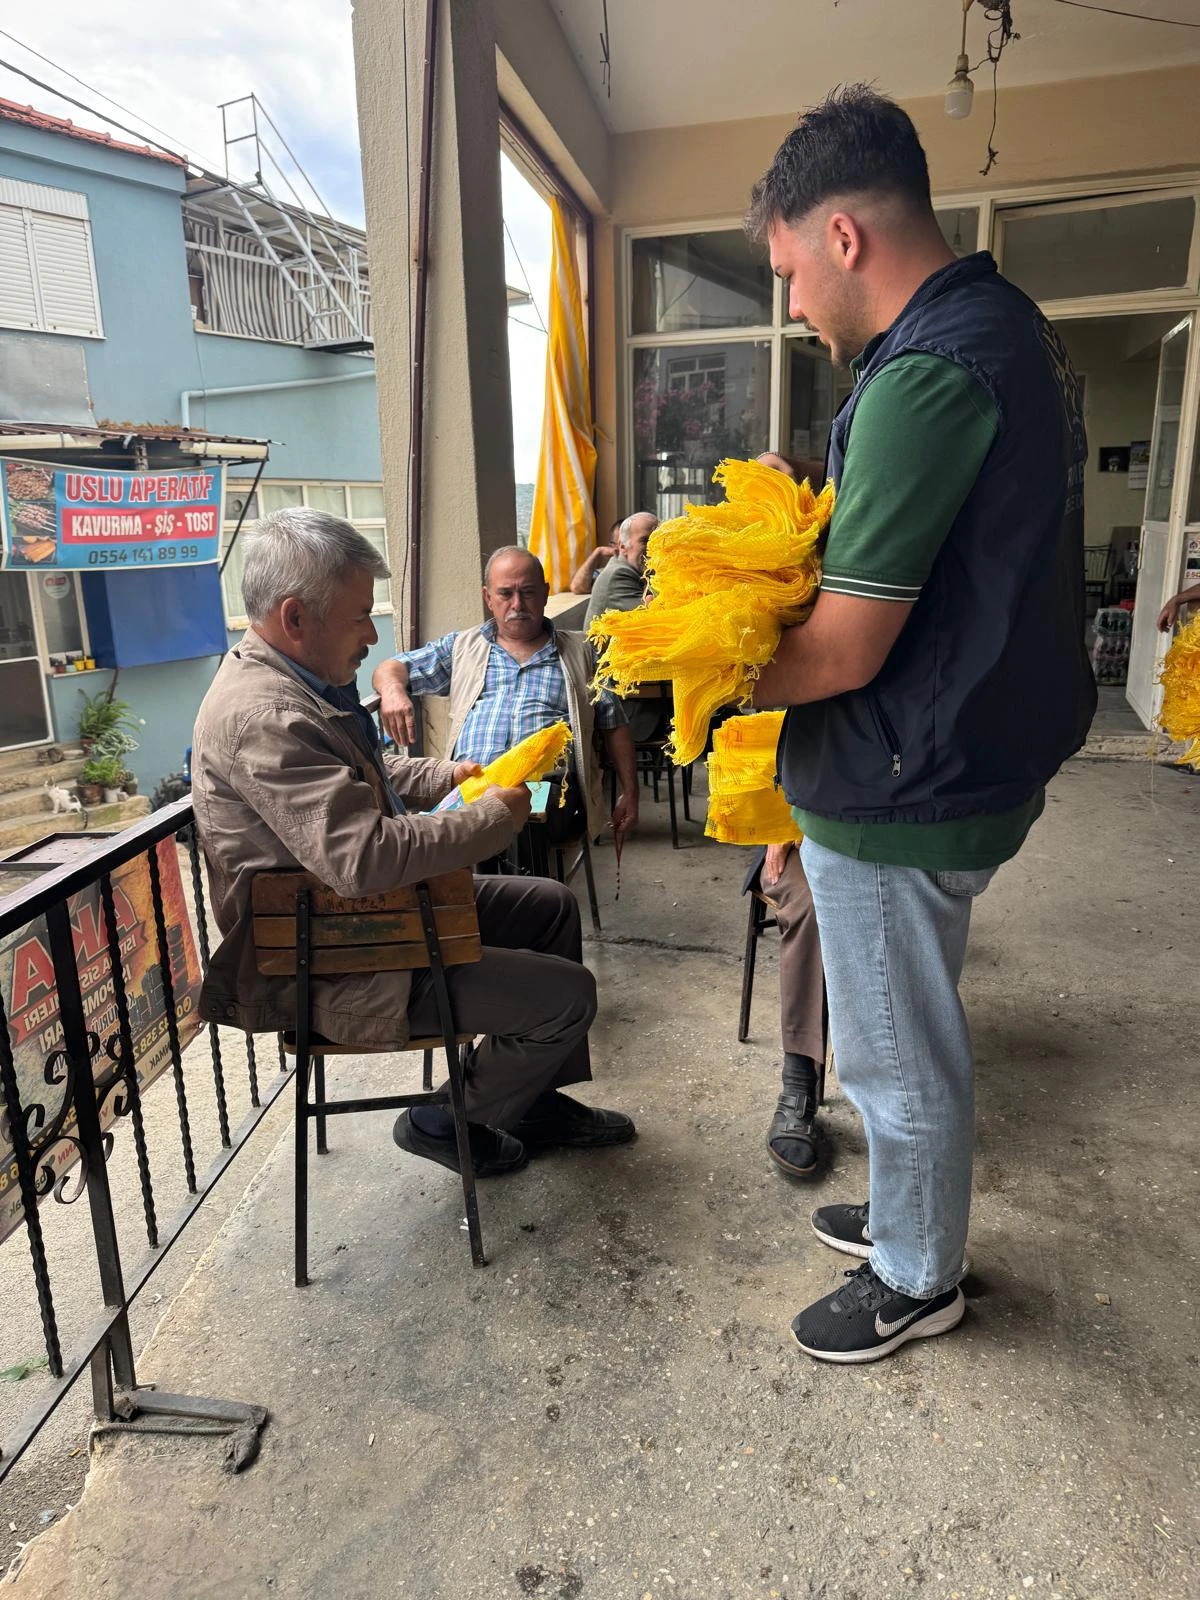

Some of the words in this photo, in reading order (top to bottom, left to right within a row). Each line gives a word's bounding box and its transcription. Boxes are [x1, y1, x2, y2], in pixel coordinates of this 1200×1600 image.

[65, 473, 124, 502] USLU
[128, 469, 214, 502] APERATİF
[71, 514, 142, 537] KAVURMA
[154, 510, 175, 535] ŞİŞ
[184, 511, 214, 532] TOST
[88, 549, 128, 564] 0554
[131, 548, 154, 562] 141
[158, 546, 176, 560] 89
[180, 545, 198, 558] 99
